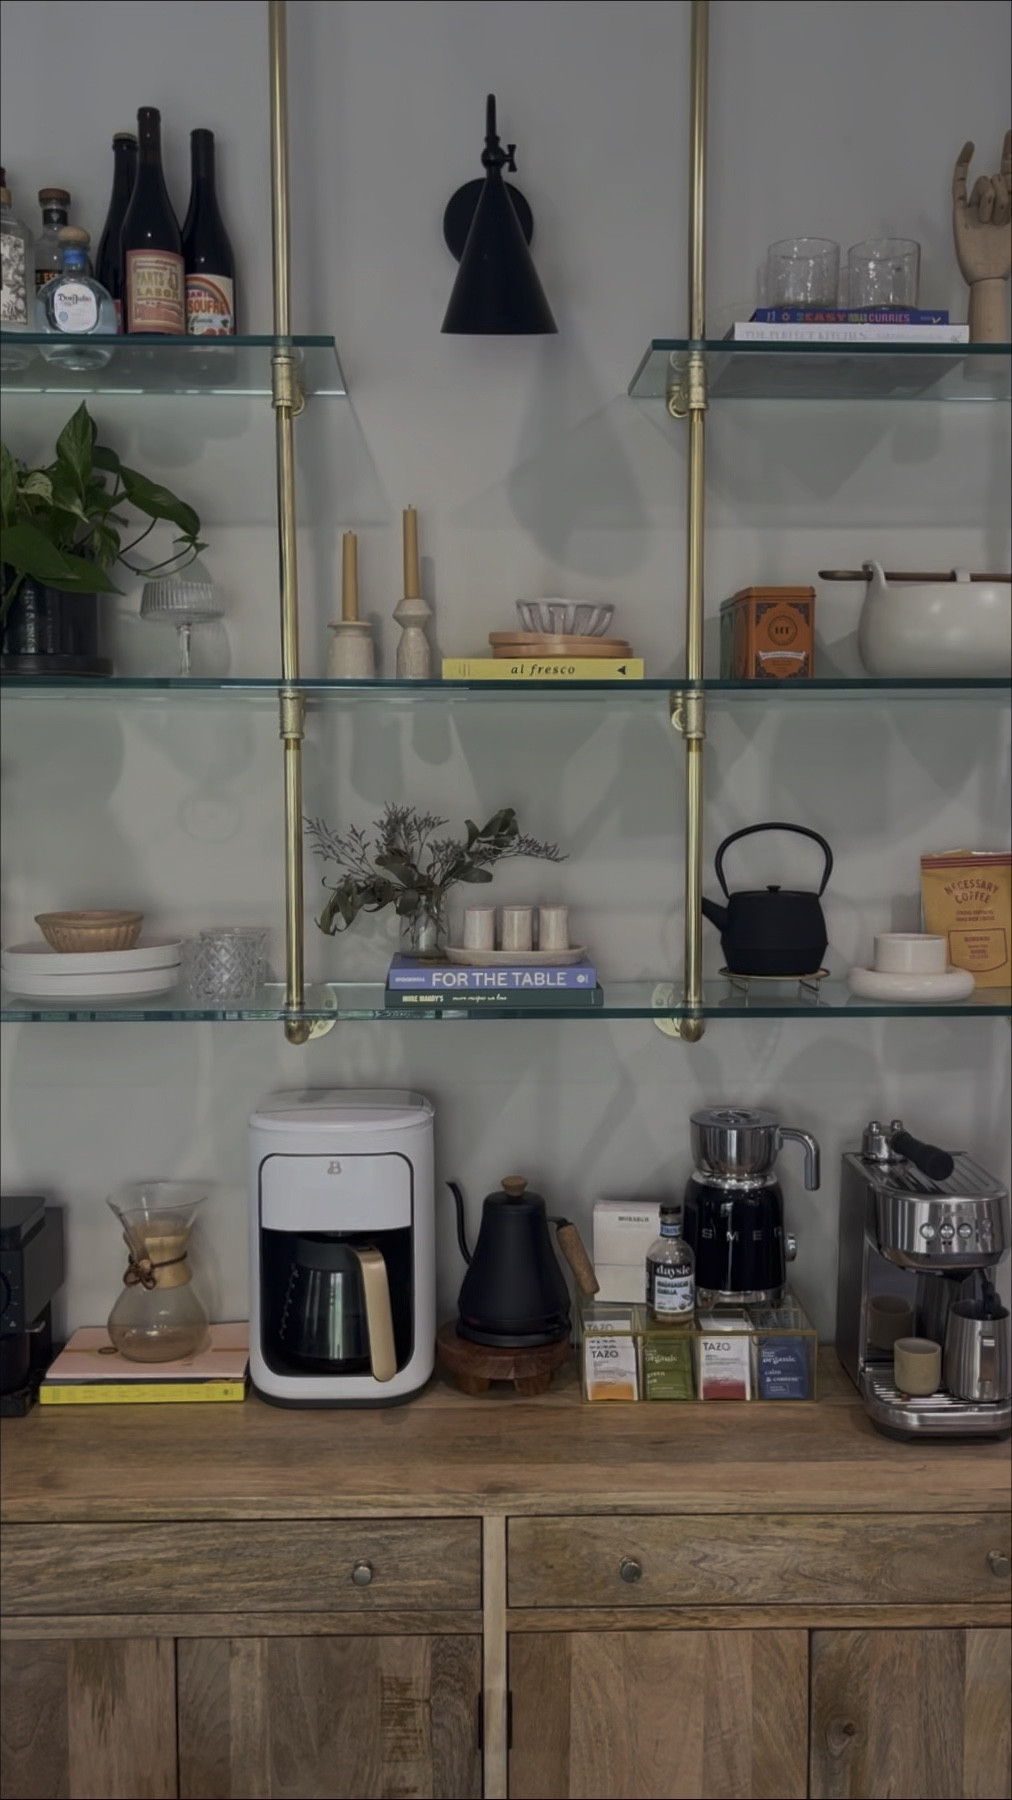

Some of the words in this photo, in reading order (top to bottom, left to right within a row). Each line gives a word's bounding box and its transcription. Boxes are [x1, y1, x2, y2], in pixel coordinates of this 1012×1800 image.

[136, 288, 179, 299] LABOR
[511, 664, 525, 674] al
[529, 664, 576, 676] fresco
[944, 879, 999, 896] NECESSARY
[954, 891, 991, 904] COFFEE
[431, 972, 468, 987] FOR
[472, 972, 508, 986] THE
[511, 972, 567, 986] TABLE
[656, 1264, 690, 1278] daysie
[703, 1342, 731, 1351] TAZO
[592, 1350, 619, 1358] TAZO
[762, 1355, 796, 1365] organic
